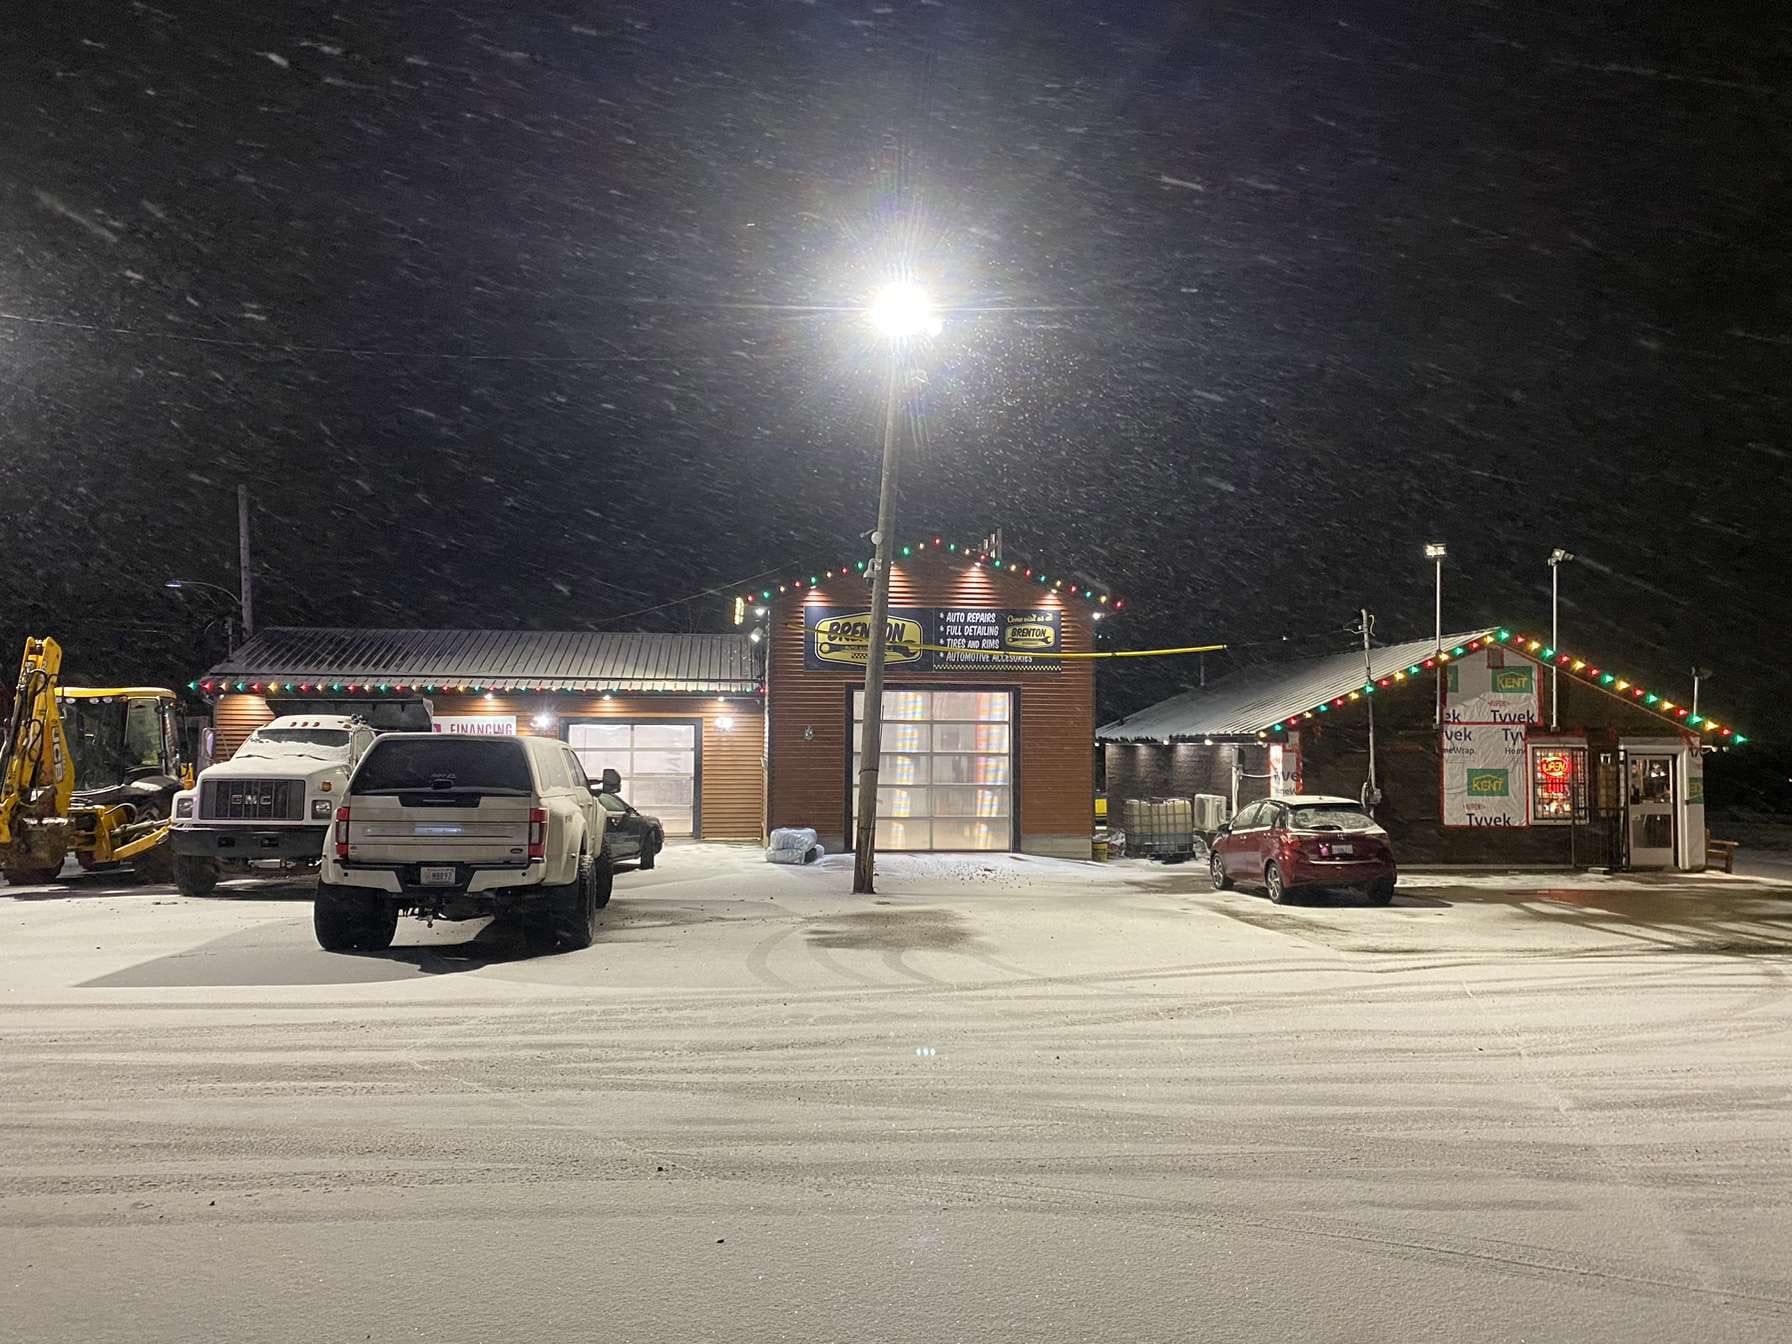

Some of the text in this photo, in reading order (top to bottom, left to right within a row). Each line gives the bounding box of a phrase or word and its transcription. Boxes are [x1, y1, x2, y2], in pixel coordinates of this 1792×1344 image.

[946, 612, 996, 623] AUTO REPAIRS
[828, 621, 906, 642] BRENON
[946, 625, 1000, 636] FULL DETAILING
[1011, 628, 1046, 637] BRENTON
[946, 638, 966, 648] TIRES
[981, 638, 1000, 649] RIMS
[946, 652, 990, 662] AUTOMOTIVE
[1497, 677, 1528, 688] KENT
[1491, 709, 1535, 724] Tyvek
[450, 723, 513, 734] FINANCING
[1471, 780, 1504, 792] KENT
[231, 794, 272, 805] GMC
[1466, 813, 1511, 827] Tyvek
